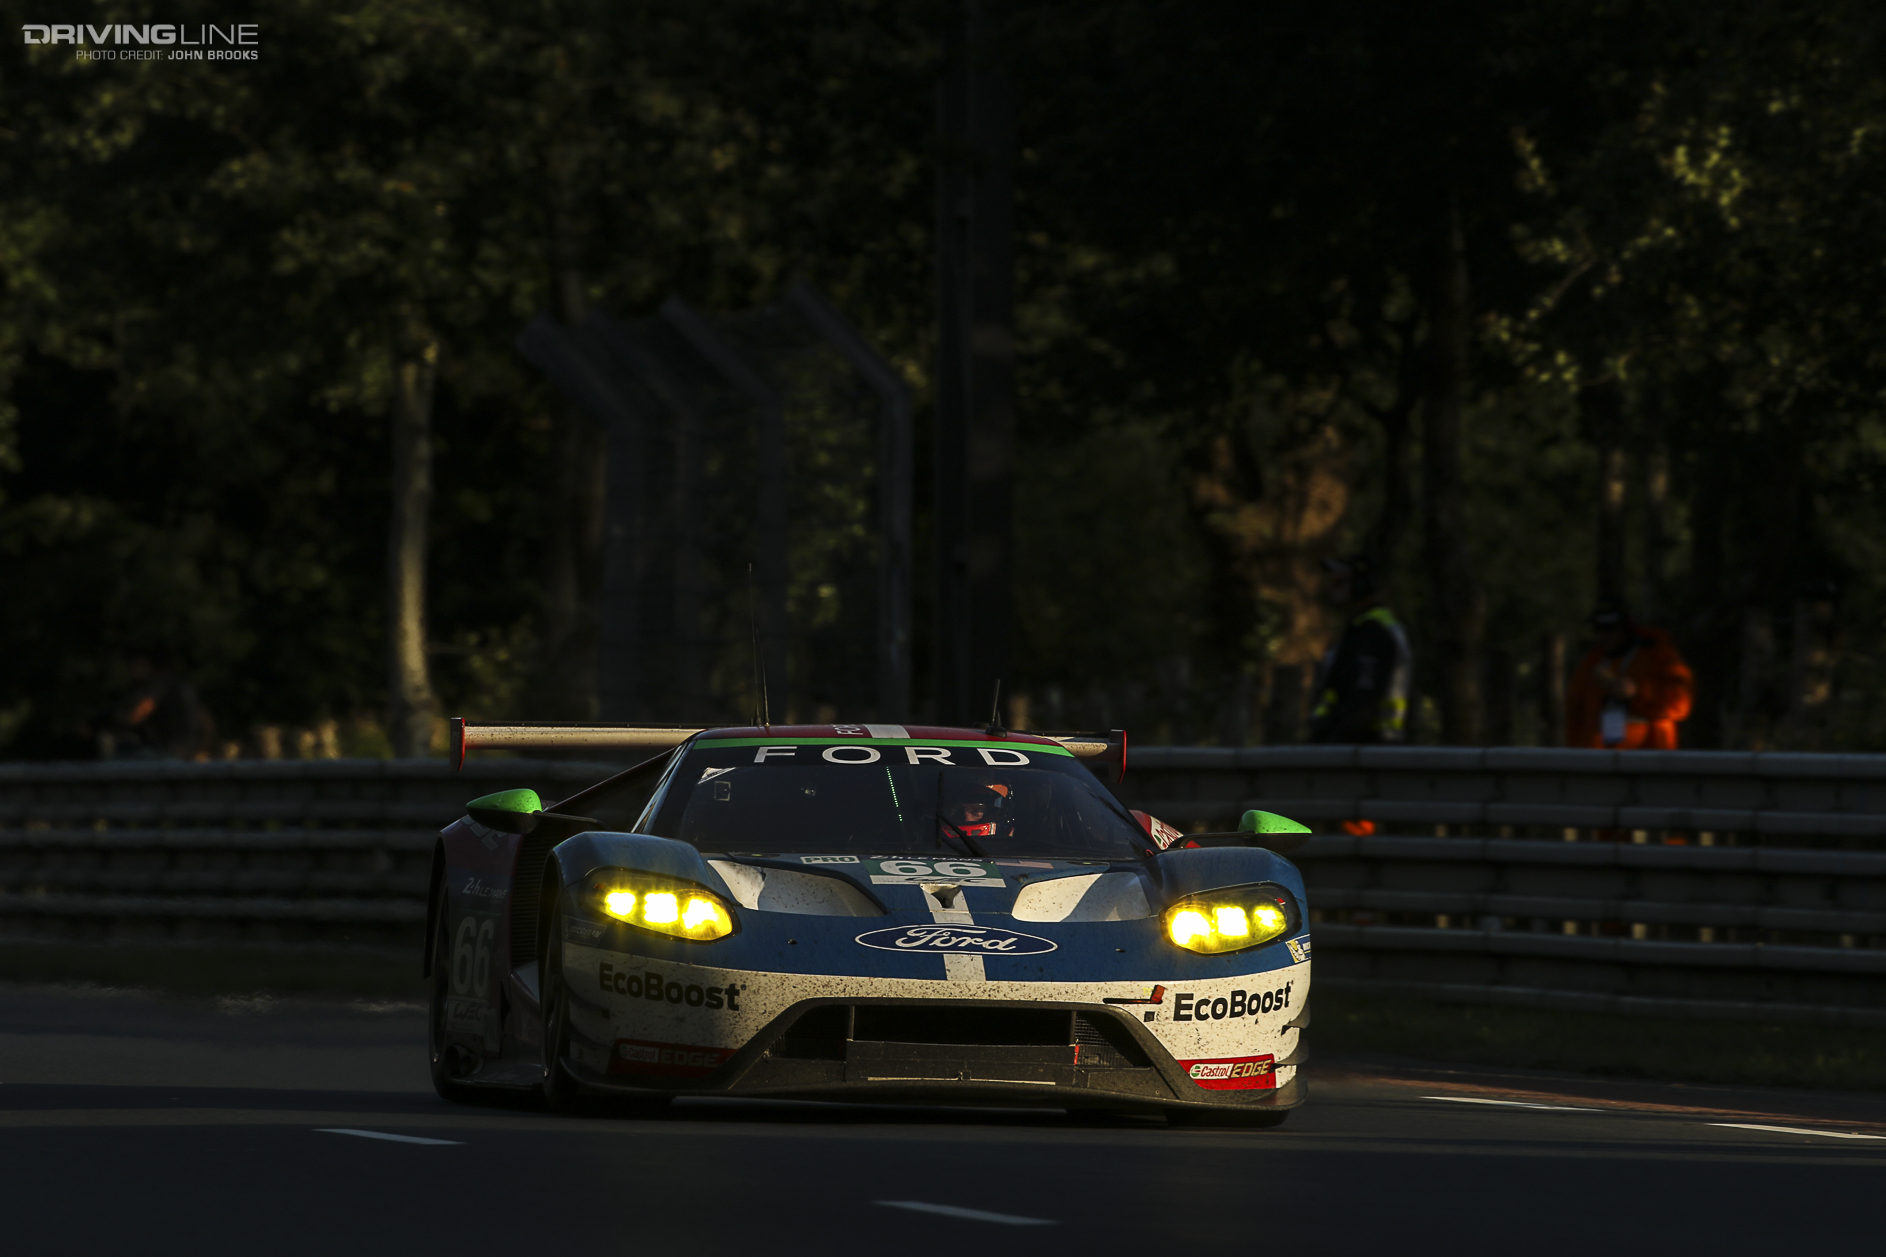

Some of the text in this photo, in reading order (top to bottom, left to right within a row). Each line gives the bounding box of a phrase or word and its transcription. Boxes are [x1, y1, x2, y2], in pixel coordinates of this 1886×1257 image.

[753, 746, 1031, 767] FORD
[805, 856, 855, 864] PRO
[880, 860, 986, 876] 66
[895, 926, 1019, 952] Ford
[454, 917, 493, 996] 66
[599, 961, 740, 1012] EcoBoost
[1173, 981, 1292, 1022] EcoBoost
[628, 1046, 721, 1069] Castrol EDGE
[1200, 1059, 1273, 1079] Castrol EDGE
